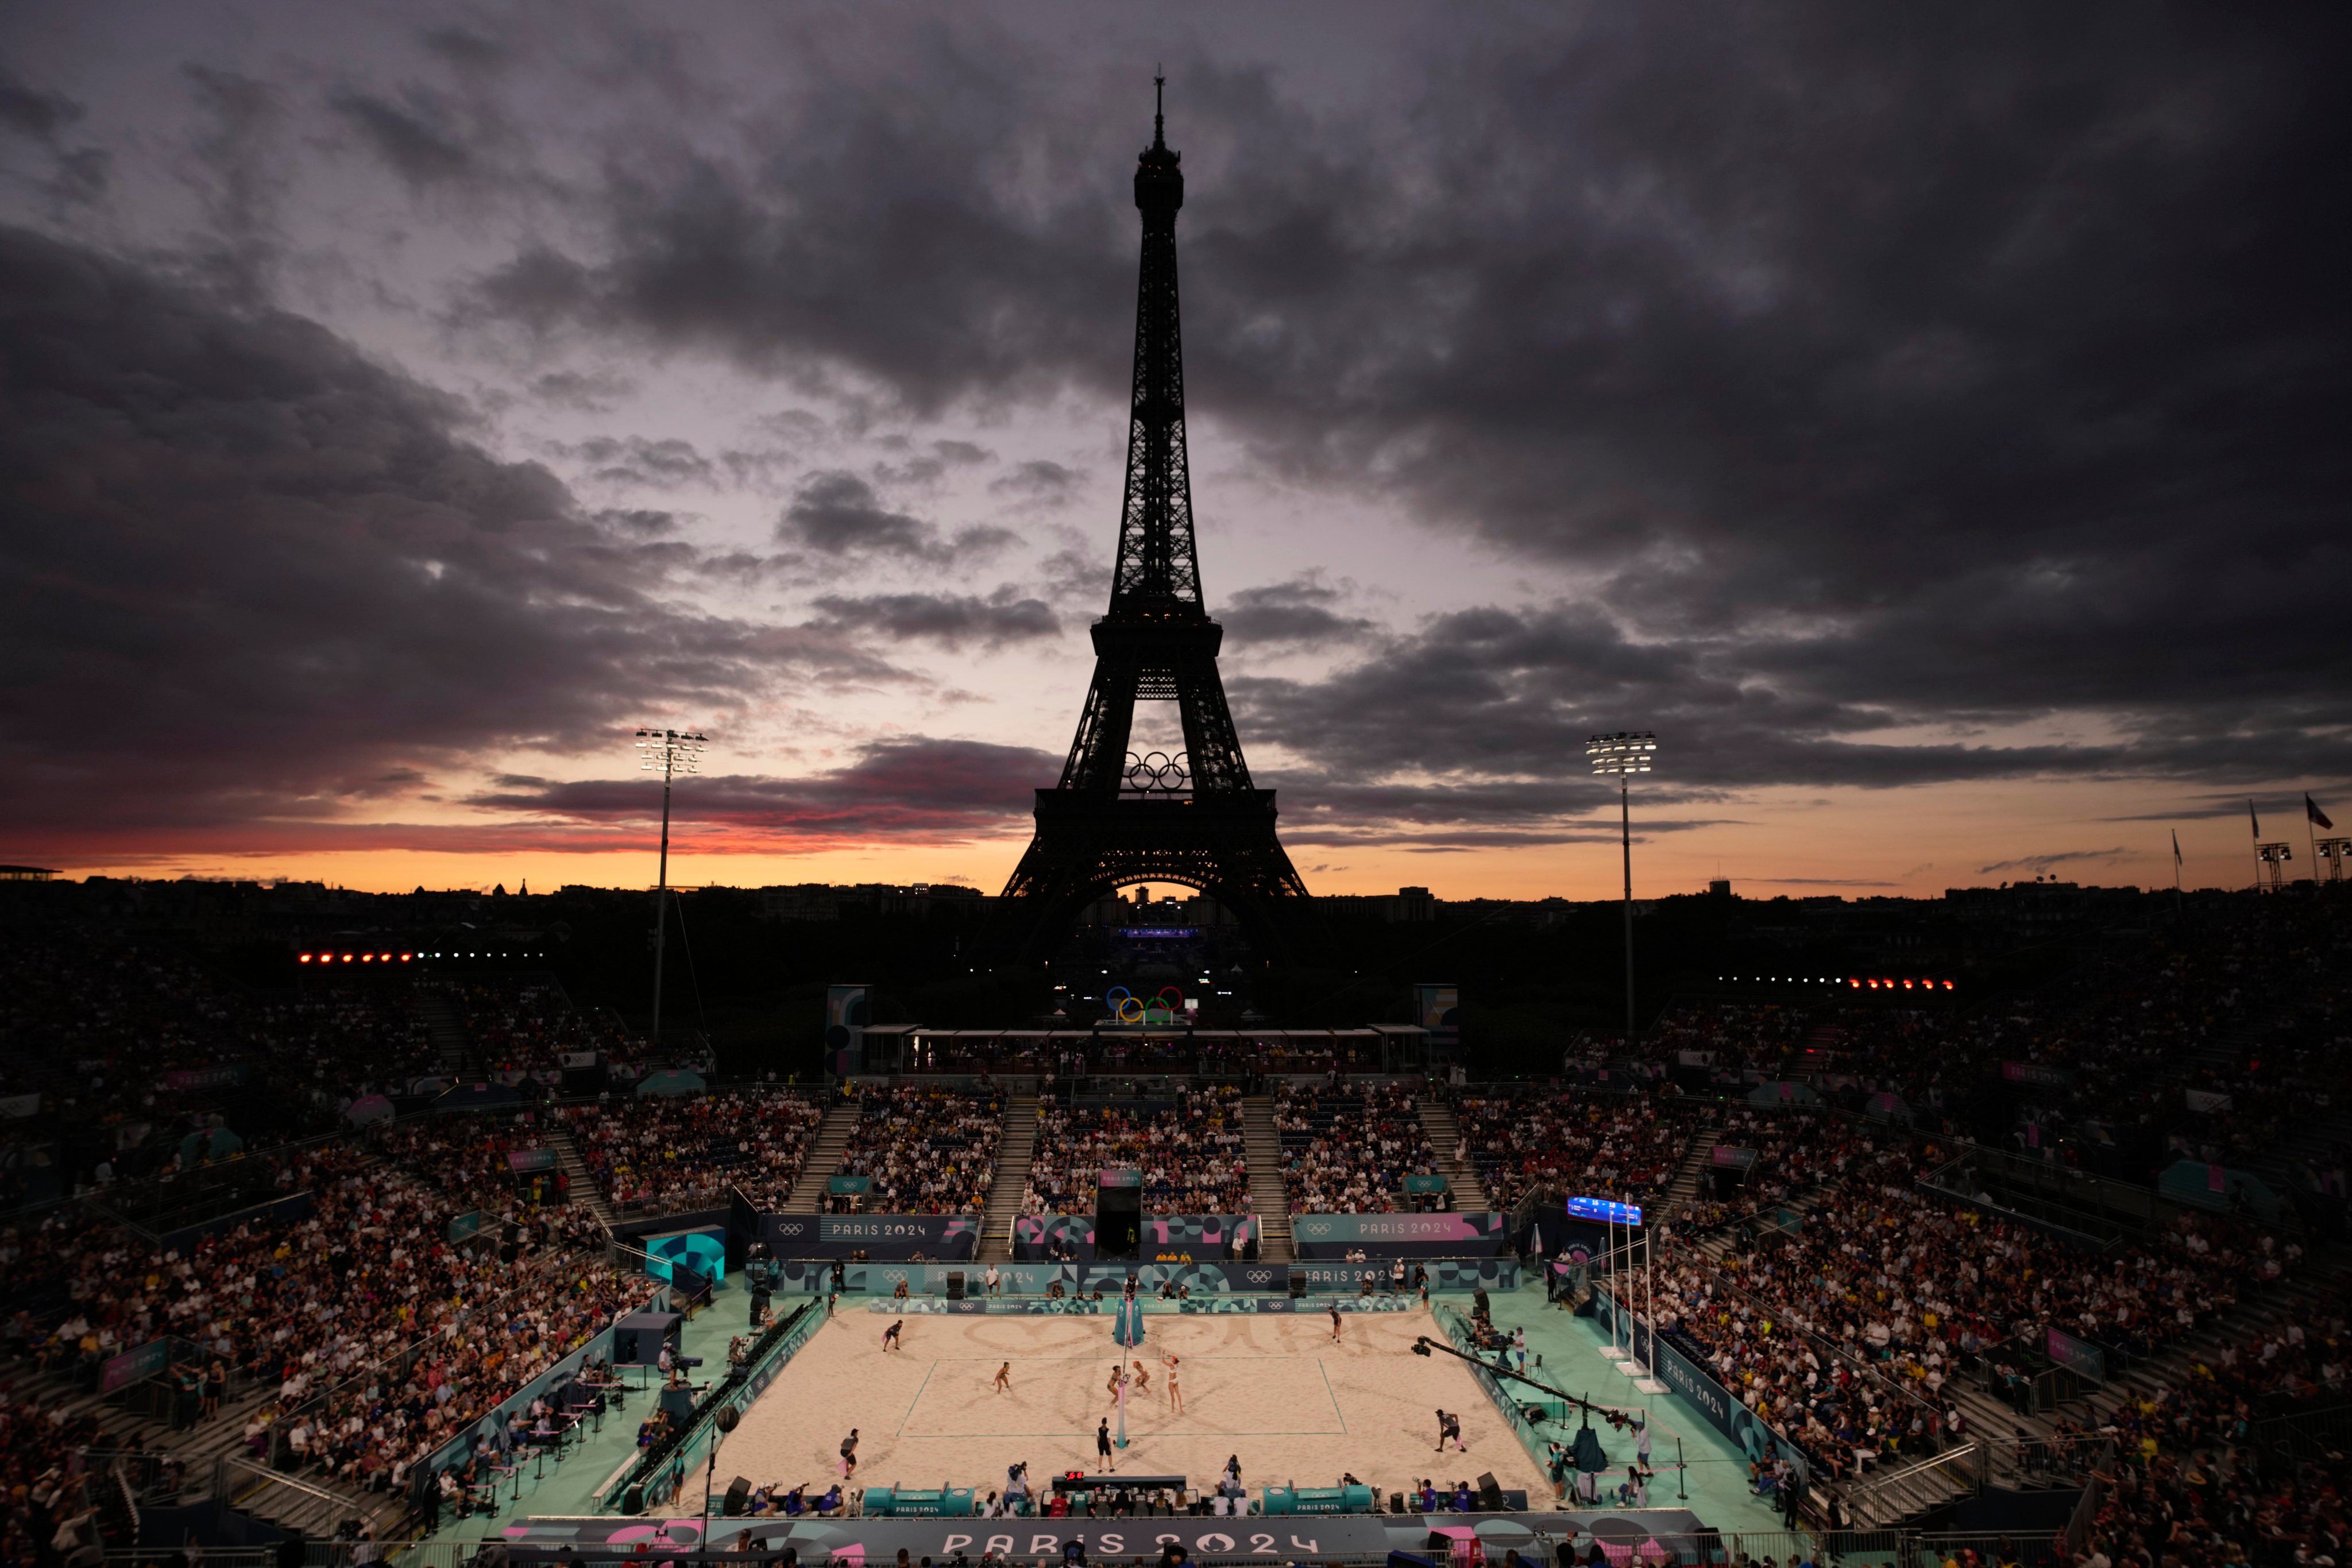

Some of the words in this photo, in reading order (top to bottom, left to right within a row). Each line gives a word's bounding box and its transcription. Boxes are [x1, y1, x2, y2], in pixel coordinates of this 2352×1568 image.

[885, 1225, 925, 1235] 2024
[1411, 1223, 1451, 1233] 2024
[1696, 1385, 1723, 1419] 2024
[1154, 1532, 1319, 1554] 2024
